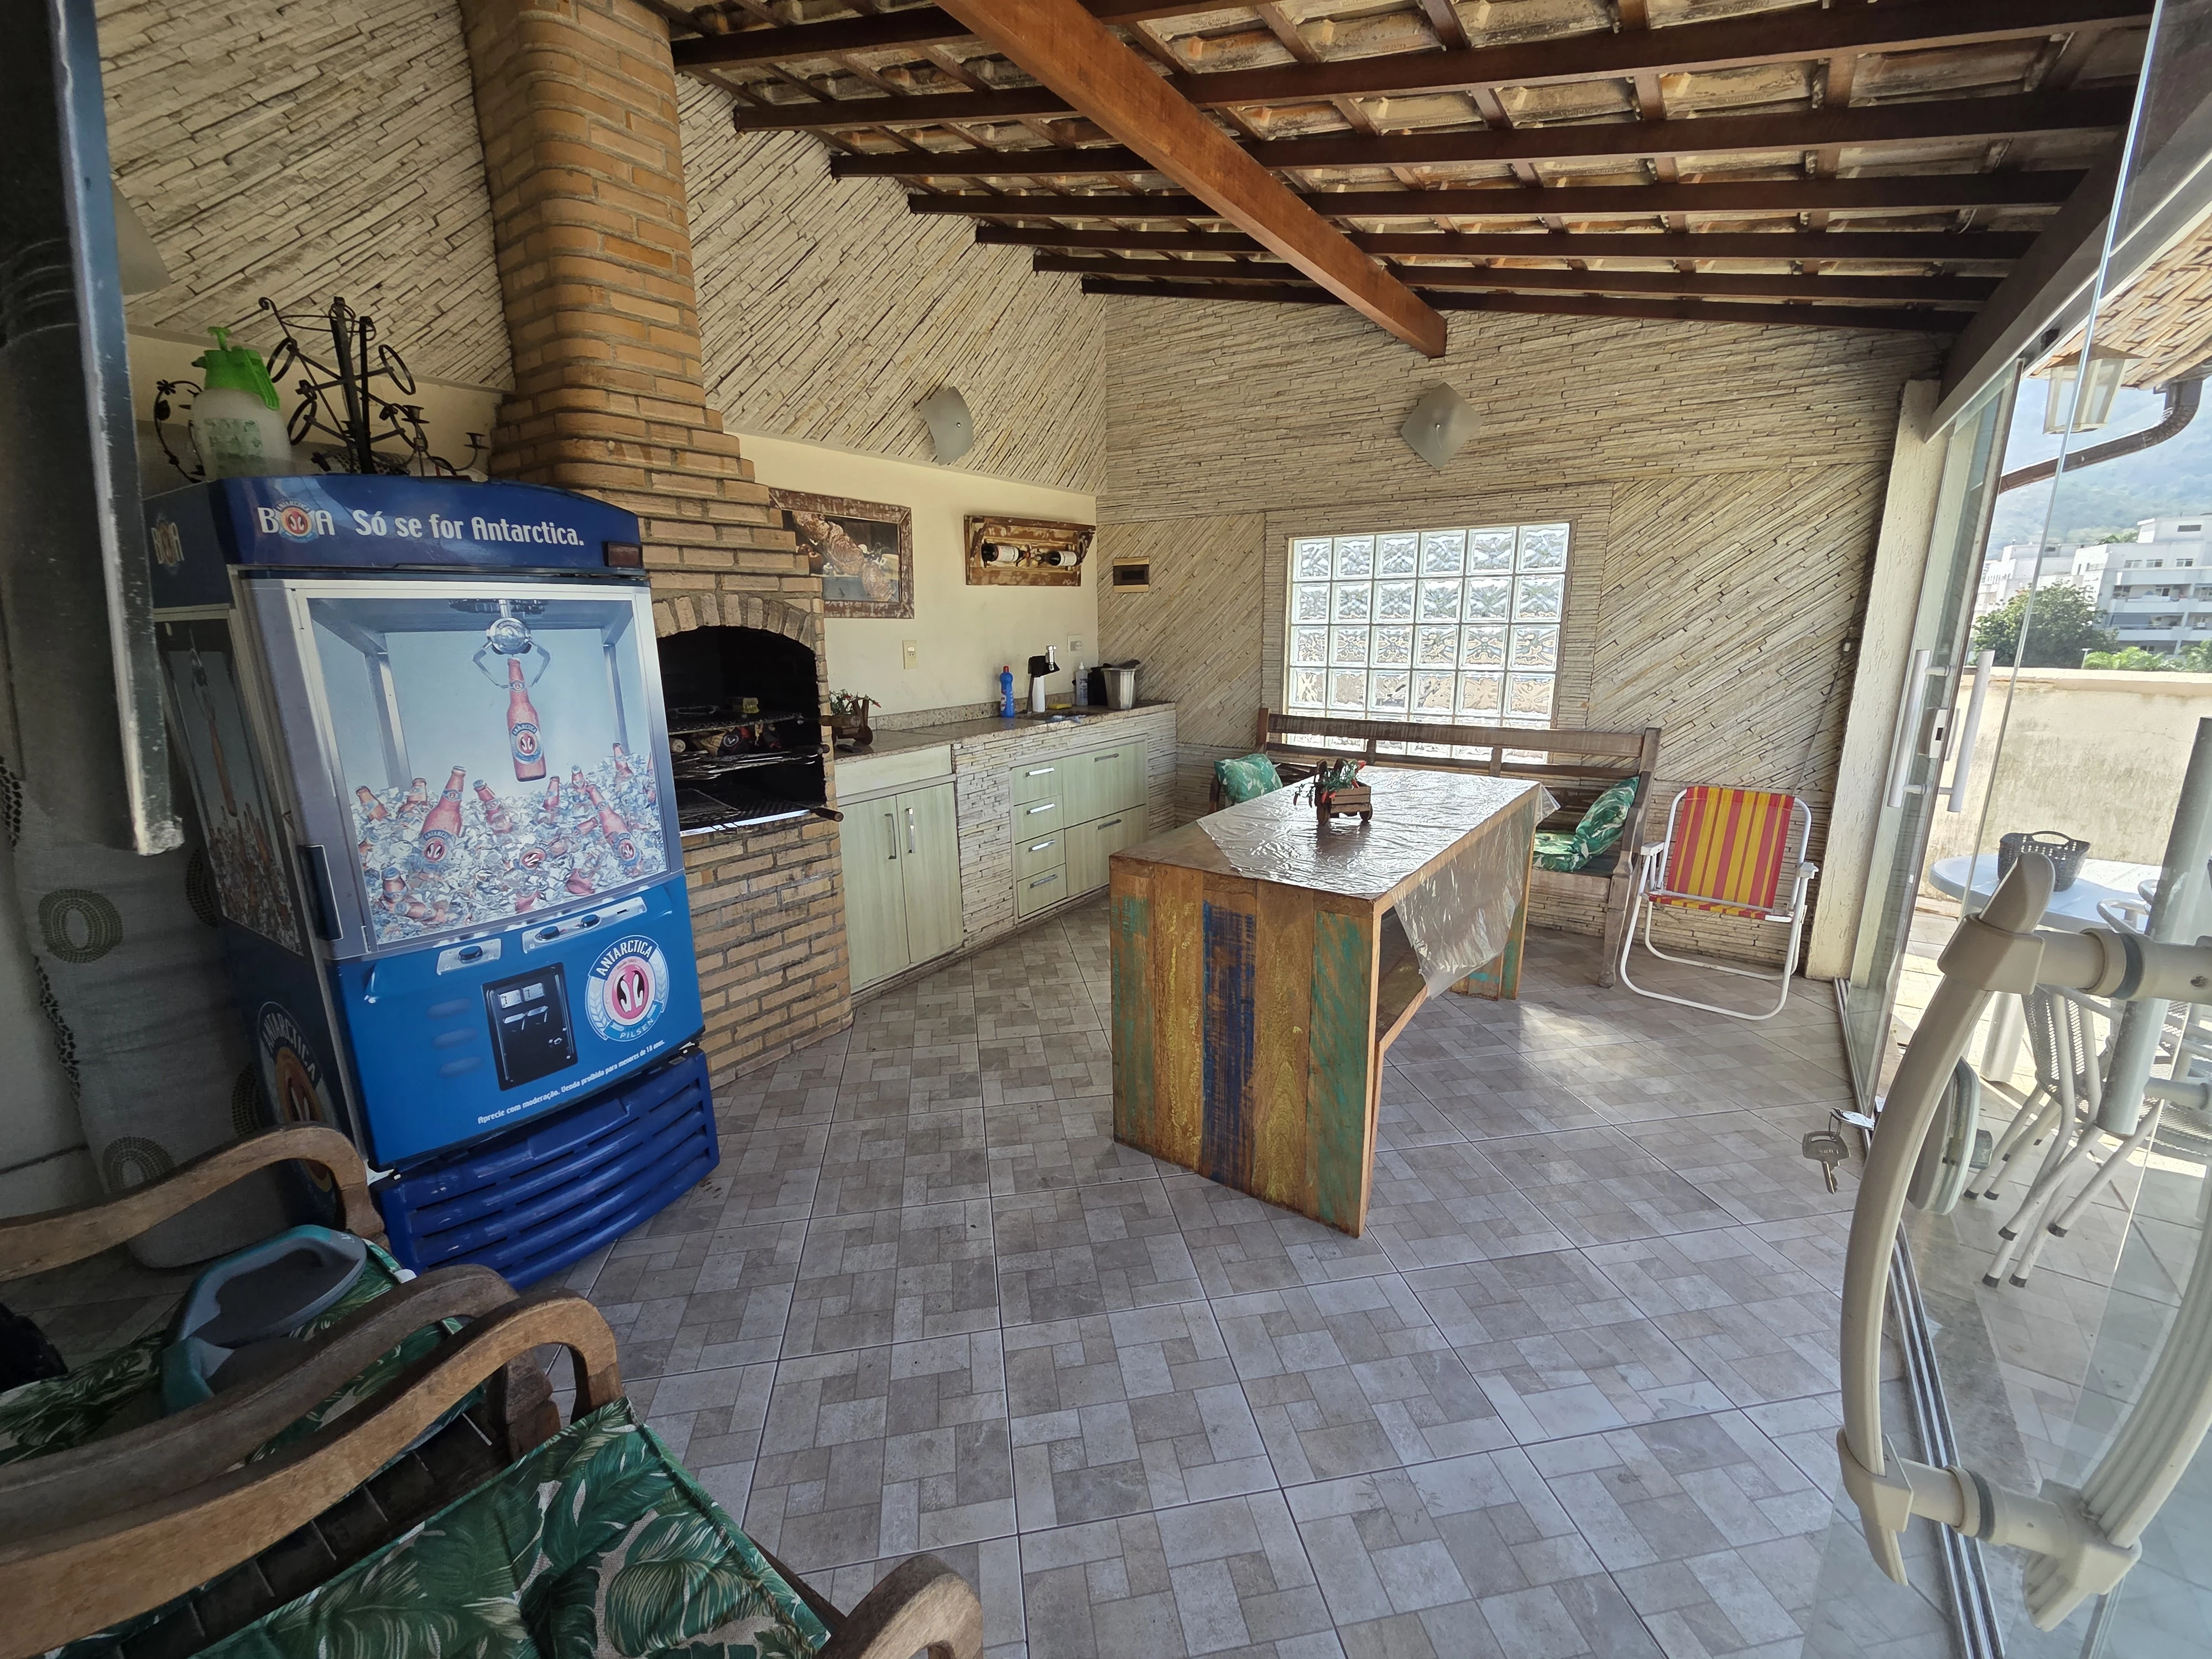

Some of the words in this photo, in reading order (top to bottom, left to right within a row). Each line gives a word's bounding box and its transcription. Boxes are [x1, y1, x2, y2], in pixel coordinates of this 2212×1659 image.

[352, 509, 387, 536] Só
[394, 518, 423, 538] se
[429, 514, 464, 539] for
[471, 517, 585, 546] Antarctica.
[596, 940, 653, 977] ANTARCTICA
[619, 1018, 654, 1039] PILSEN
[262, 1013, 316, 1082] ANTARCTICA
[477, 1110, 505, 1124] Aprecie
[506, 1104, 521, 1114] com
[522, 1089, 560, 1109] moderação.
[581, 1070, 604, 1086] proibida
[605, 1063, 618, 1075] para
[618, 1053, 640, 1068] menores
[639, 1048, 646, 1057] de
[646, 1045, 654, 1053] 18
[653, 1040, 665, 1050] anos.
